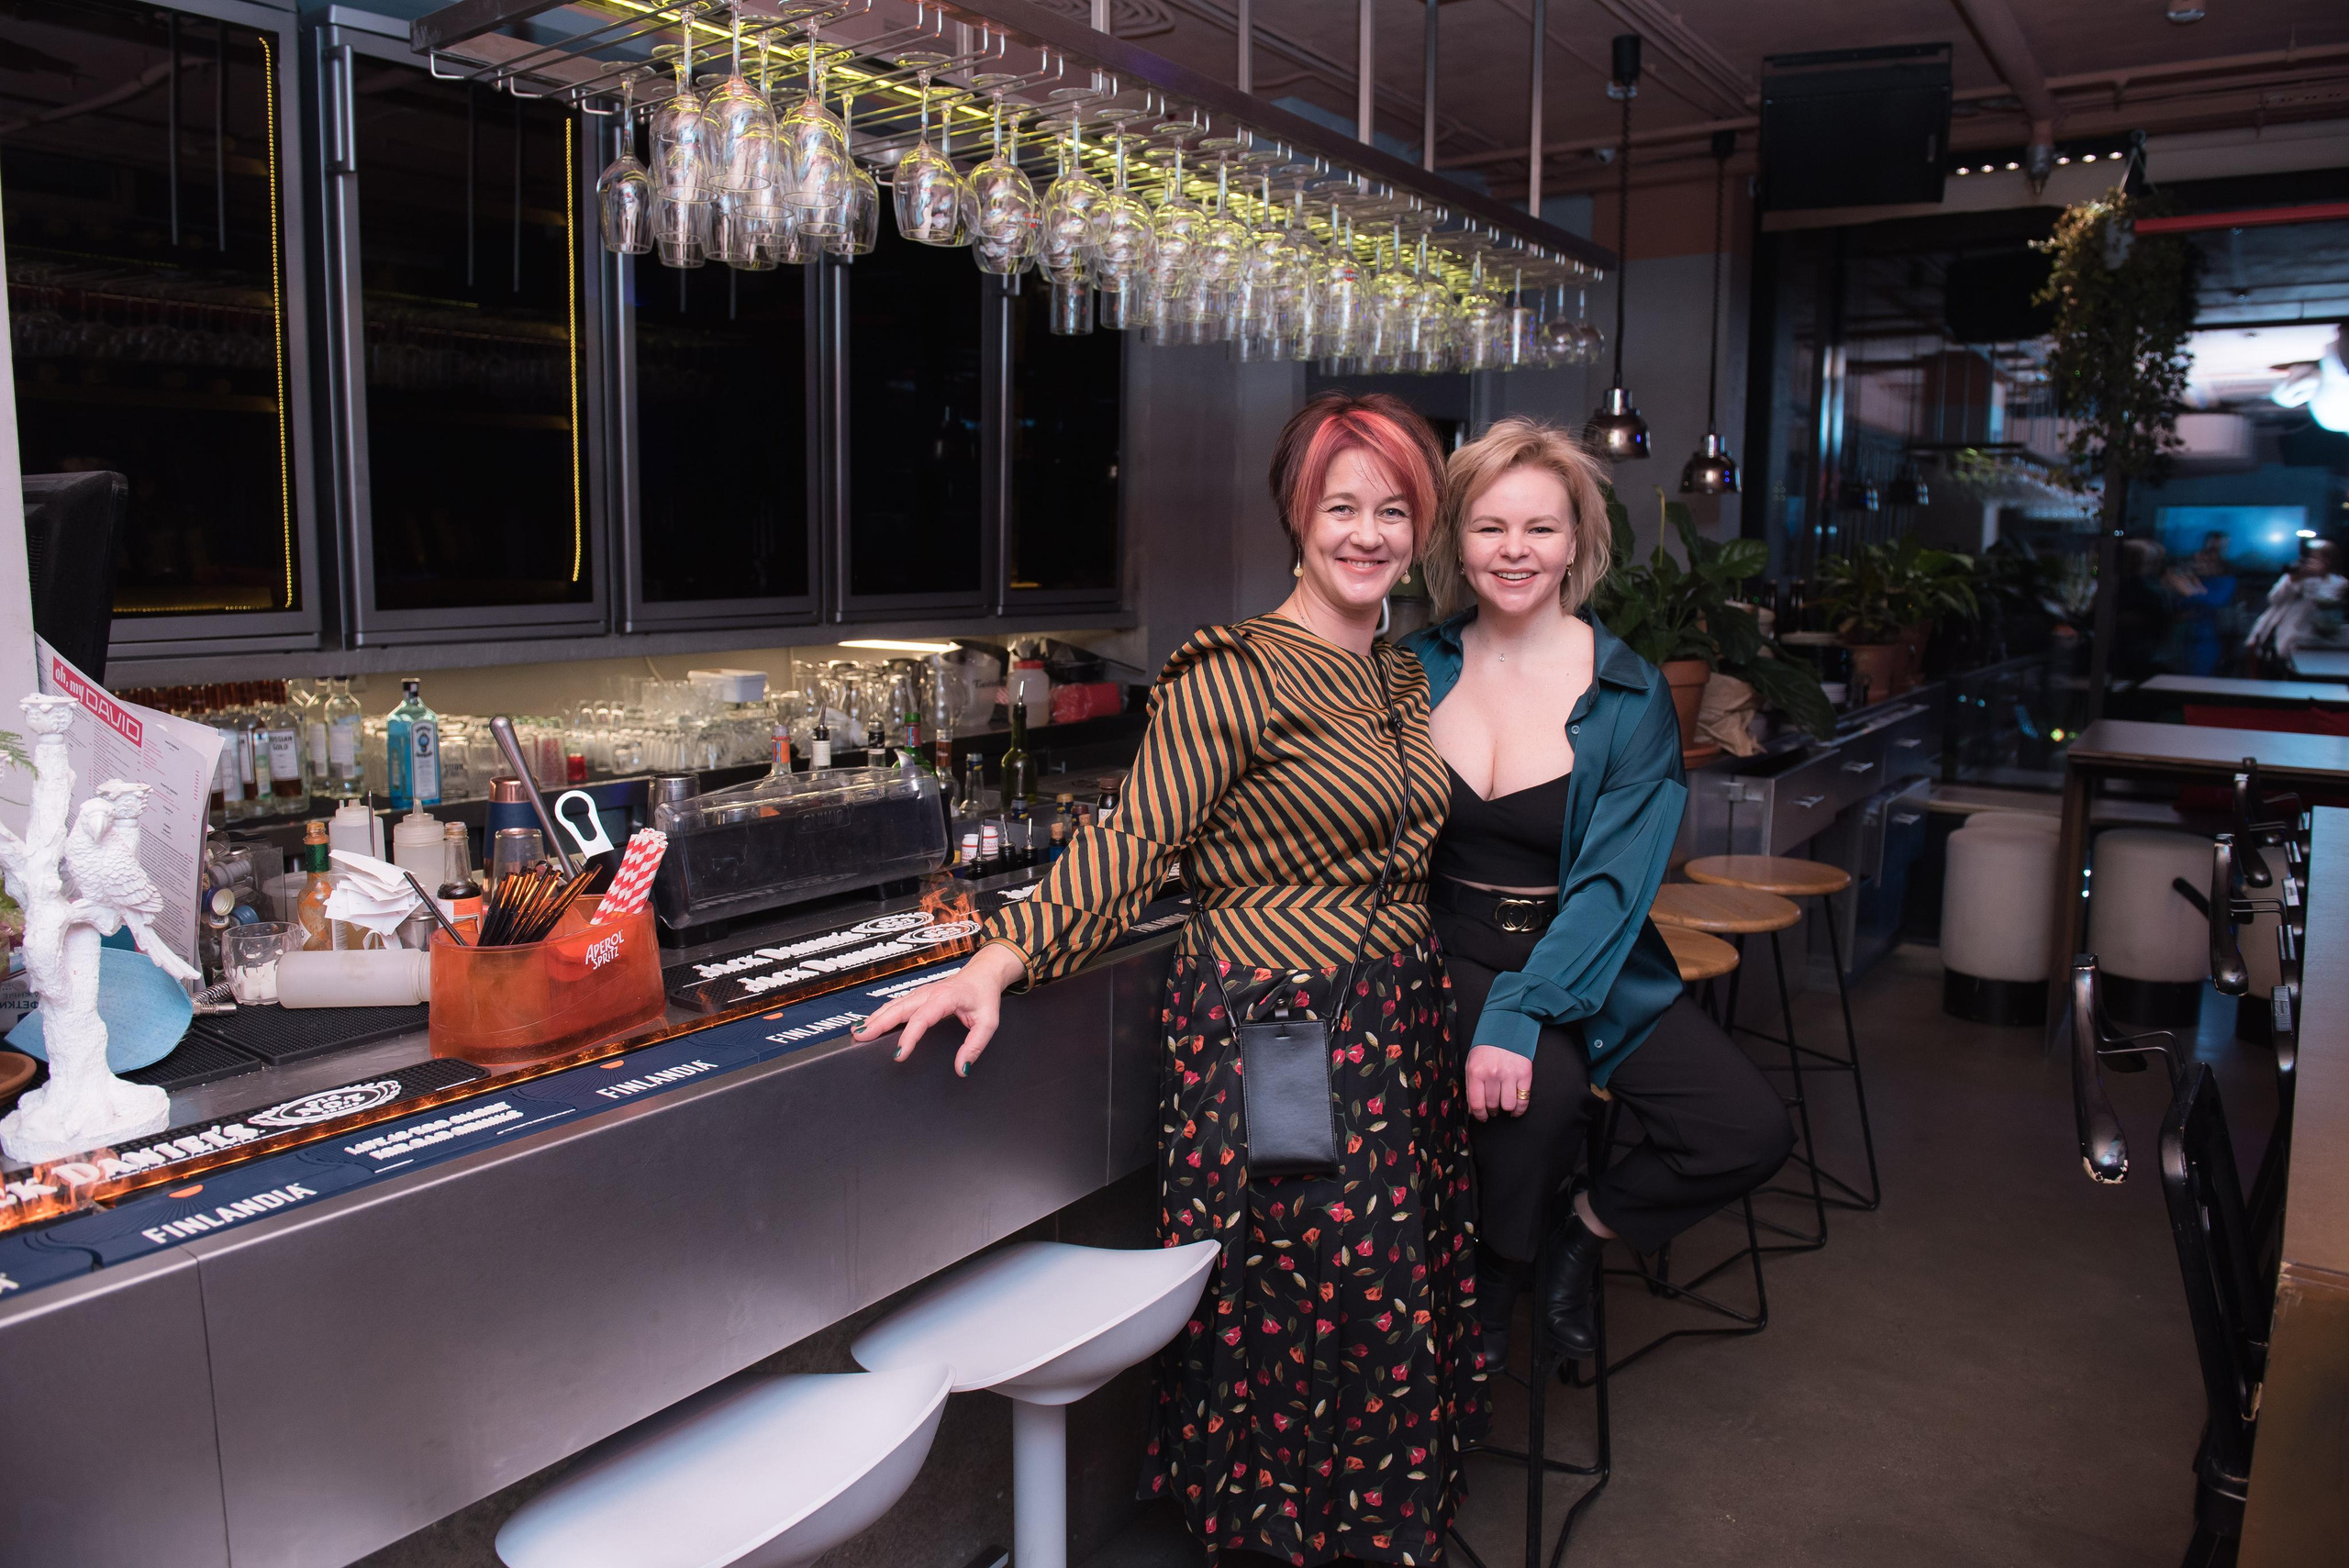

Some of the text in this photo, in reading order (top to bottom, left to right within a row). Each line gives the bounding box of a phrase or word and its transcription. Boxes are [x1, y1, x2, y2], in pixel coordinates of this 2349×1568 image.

[56, 665, 69, 688] oh,
[70, 680, 84, 703] my
[85, 687, 140, 742] DAVID
[585, 929, 625, 965] APEROL
[0, 1000, 39, 1009] ФЕТКИ
[4, 991, 39, 1000] АЖНЫЕ
[765, 1011, 870, 1044] FINLANDIA
[596, 1059, 718, 1099] FINLANDIA
[50, 1123, 260, 1187] DANIEL'S
[141, 1183, 318, 1244] FINLANDIA
